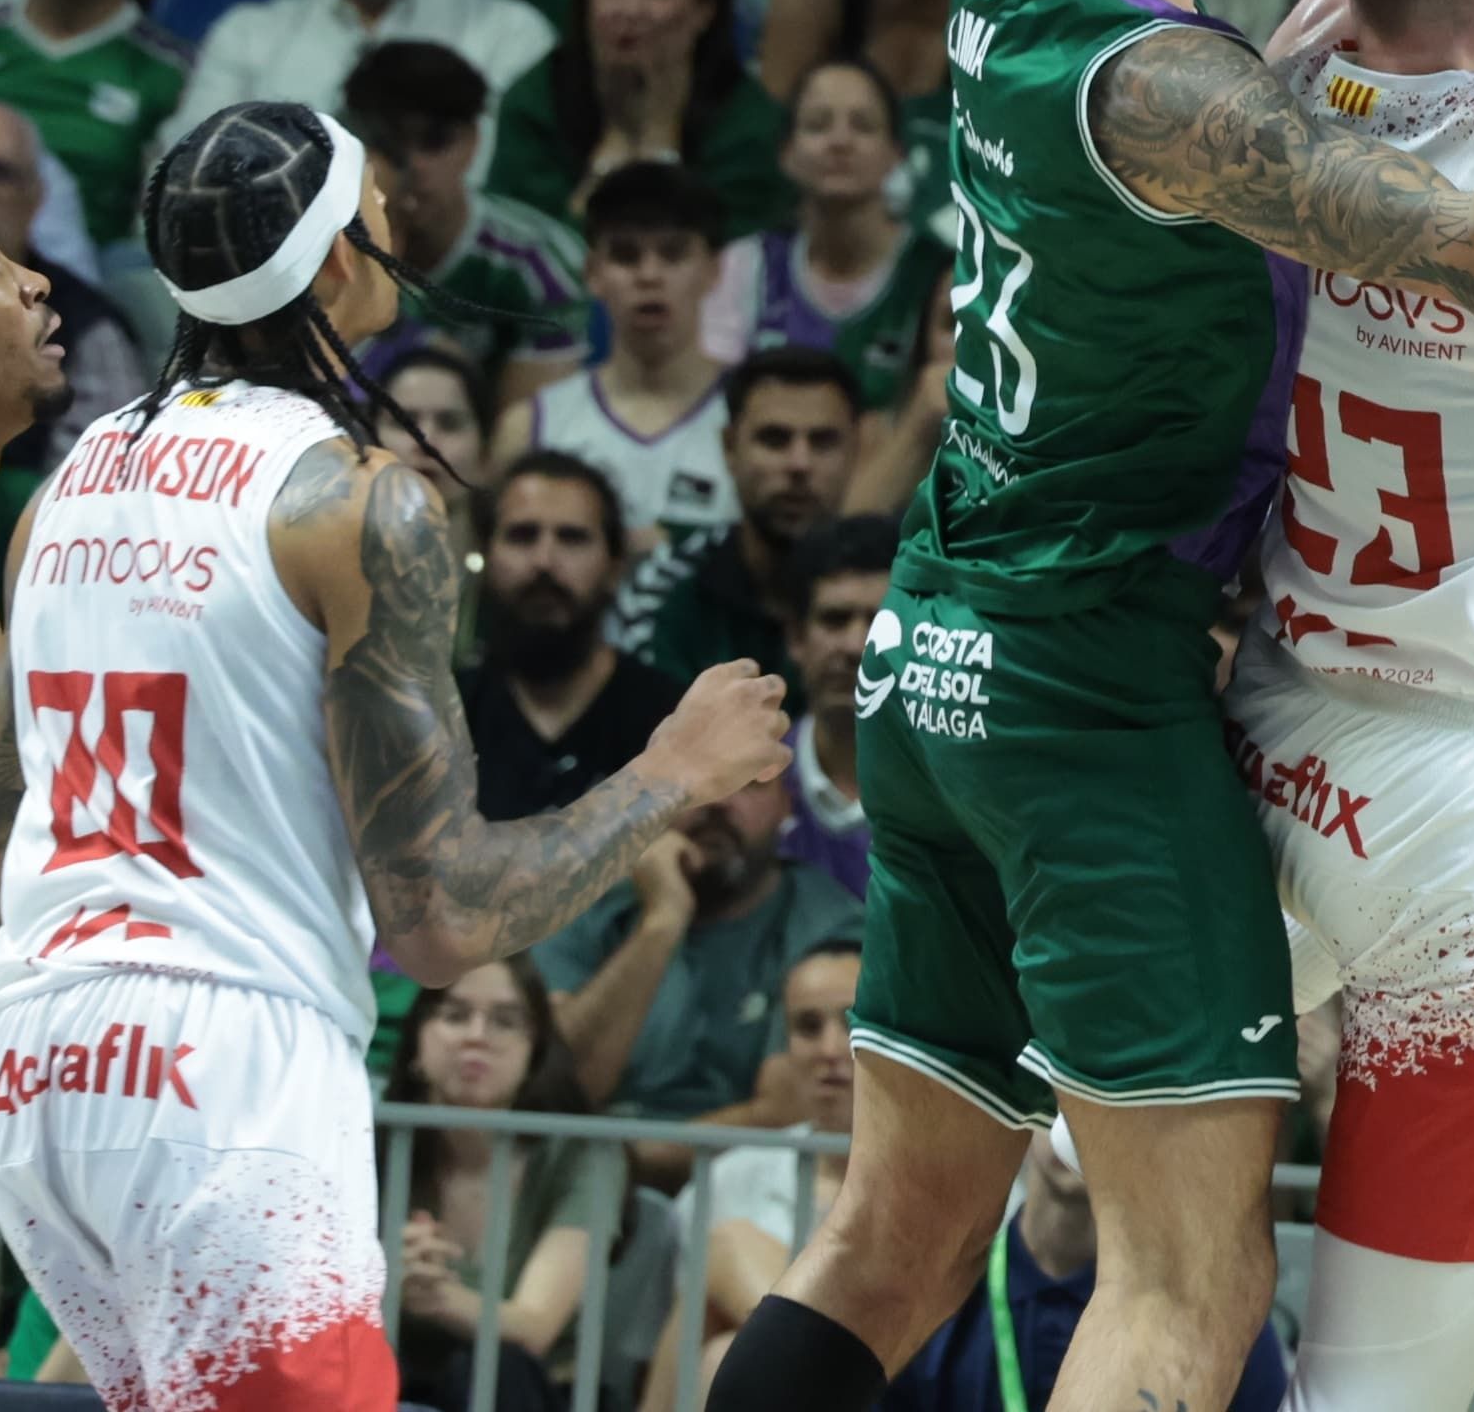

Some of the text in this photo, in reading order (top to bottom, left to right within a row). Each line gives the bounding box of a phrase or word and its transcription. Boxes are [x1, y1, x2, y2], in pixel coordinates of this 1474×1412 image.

[948, 7, 997, 81] LIMA
[950, 181, 1038, 436] 23
[1356, 325, 1468, 361] by AVINENT
[913, 621, 993, 669] COSTA
[938, 669, 990, 705] SOL
